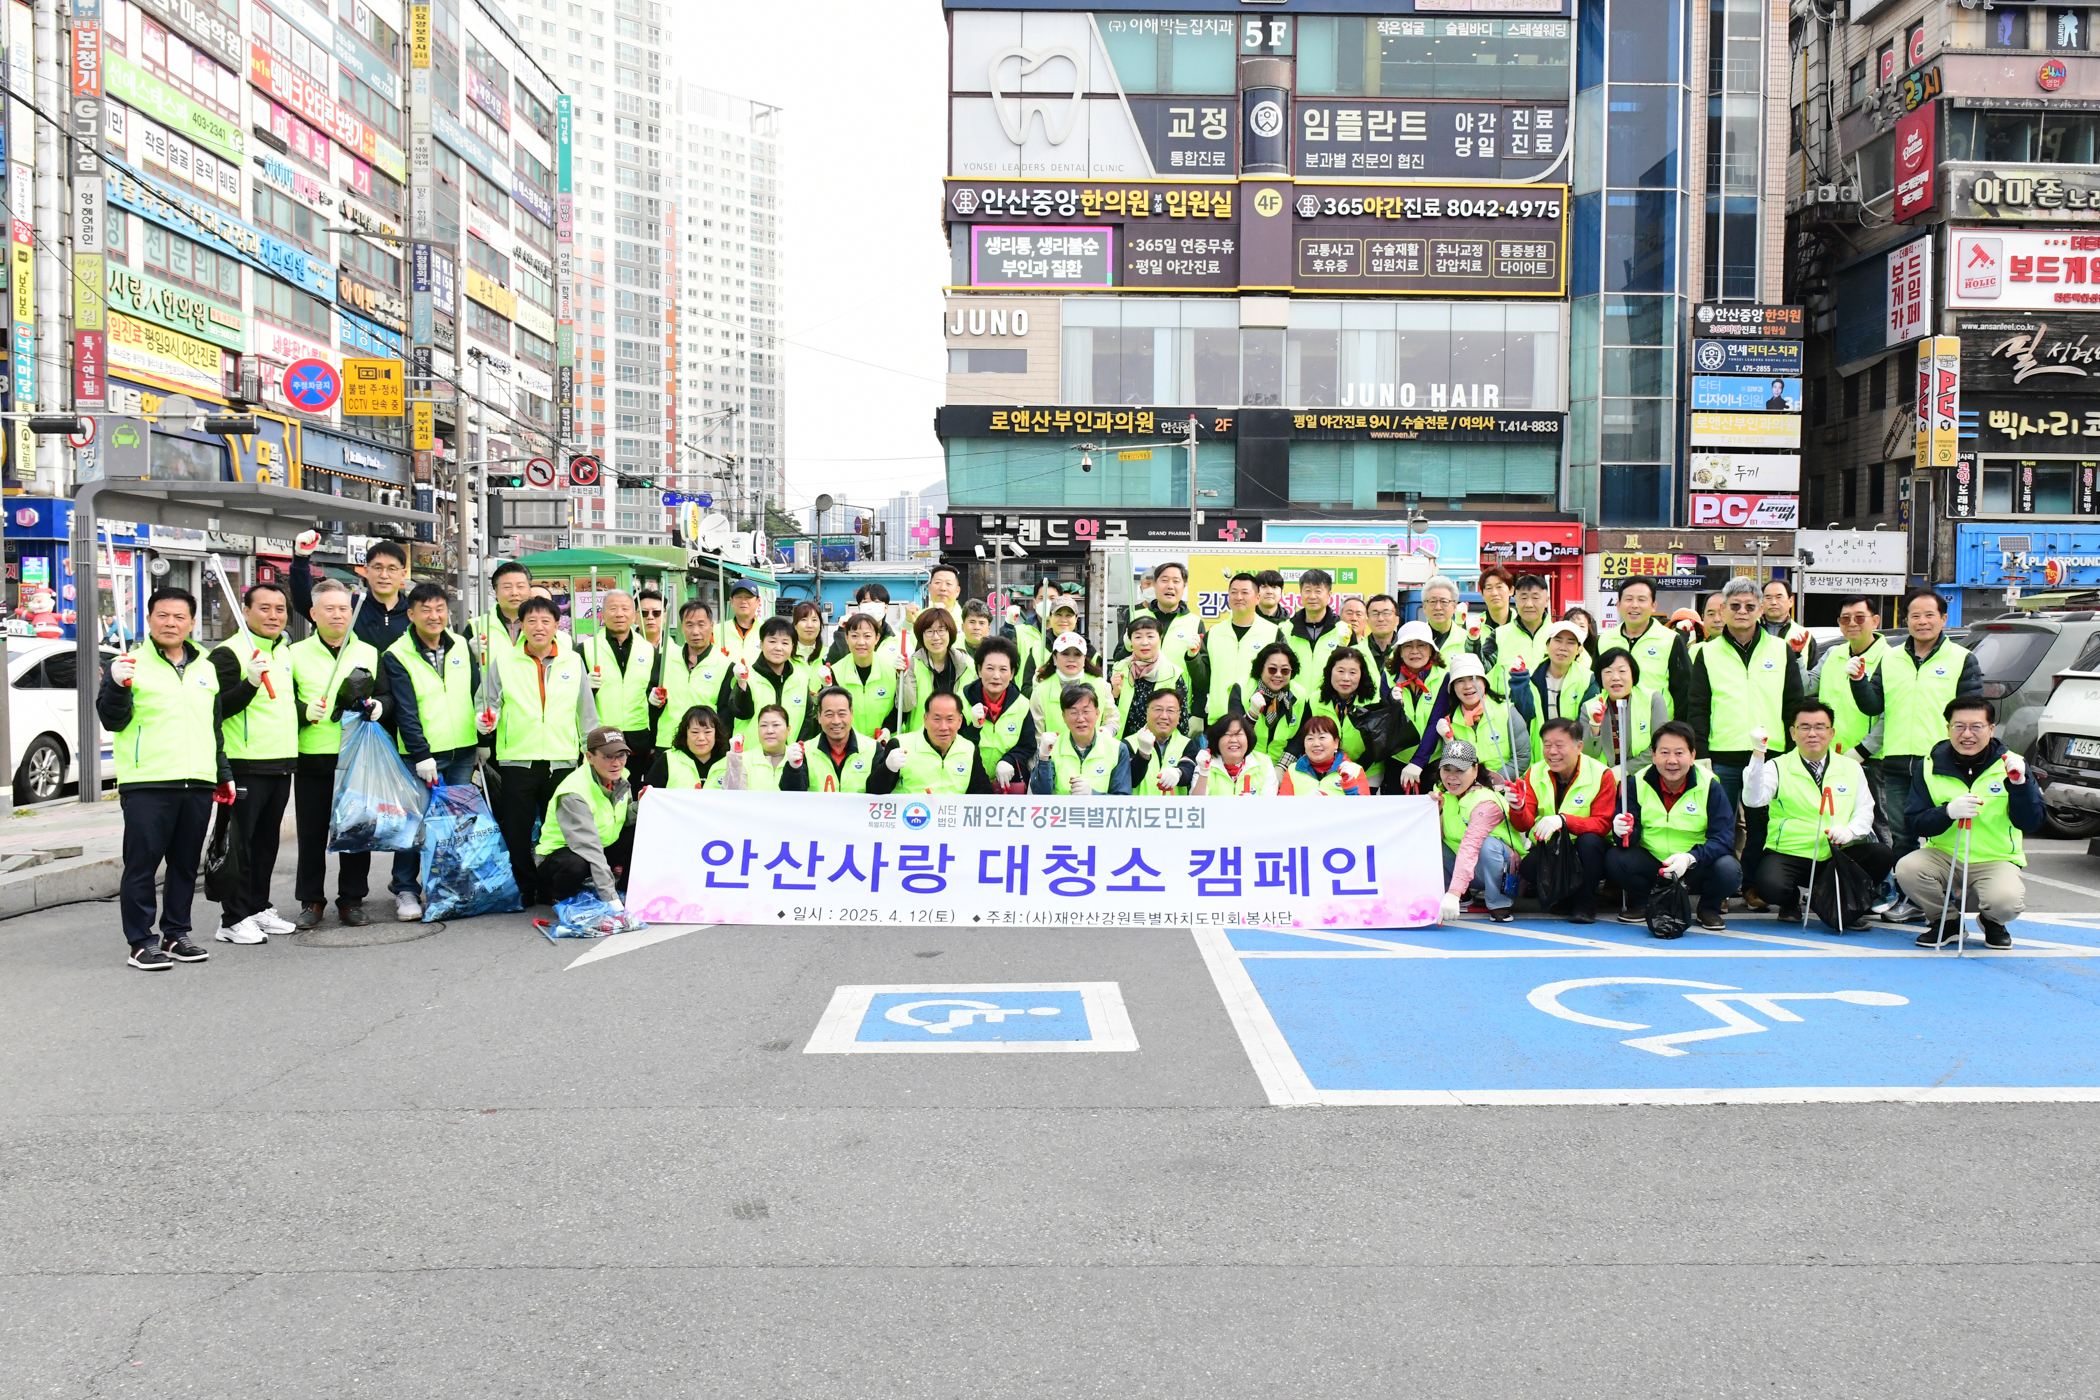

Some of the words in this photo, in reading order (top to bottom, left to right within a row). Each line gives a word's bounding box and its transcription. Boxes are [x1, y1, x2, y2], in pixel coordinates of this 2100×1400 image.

[415, 13, 427, 50] 요양보호사
[1108, 20, 1127, 33] (구)
[1130, 18, 1234, 36] 이해박는집치과
[1245, 21, 1287, 48] 5F
[1377, 21, 1425, 35] 작은얼굴
[1445, 21, 1493, 36] 슬림바디
[1507, 23, 1567, 38] 스페셜웨딩
[76, 29, 97, 90] 보청기
[1904, 66, 1942, 111] 25시
[192, 112, 226, 141] 403-2341
[1168, 107, 1228, 140] 교정
[1303, 108, 1427, 142] 임플란트
[1455, 112, 1497, 134] 야간
[1512, 110, 1554, 130] 진료
[1454, 136, 1495, 158] 당일
[1512, 134, 1554, 155] 진료
[1170, 151, 1226, 167] 통합진료
[1305, 153, 1347, 169] 분과별
[1351, 153, 1393, 169] 전문의
[1397, 154, 1425, 170] 협진
[963, 162, 998, 172] YONSEI
[1002, 163, 1046, 172] LEADERS
[1051, 164, 1087, 172] DENTAL
[1093, 164, 1125, 173] CLINIC
[1975, 178, 2065, 208] 아마존
[1165, 190, 1232, 218] 입원실
[1257, 195, 1279, 210] 4F
[1323, 197, 1442, 218] 365야간진료
[985, 237, 1036, 257] 생리통,
[1036, 237, 1100, 256] 생리불순
[1135, 238, 1178, 255] 365일
[1180, 239, 1235, 255] 연중무휴
[1307, 243, 1354, 257] 교통사고
[1371, 243, 1420, 257] 수술재활
[1436, 243, 1483, 257] 추나교정
[1500, 244, 1547, 258] 통증봉침
[1001, 259, 1049, 278] 부인과
[1051, 260, 1083, 278] 질환
[1135, 259, 1164, 275] 평일
[1166, 259, 1221, 275] 야간진료
[1312, 259, 1349, 274] 후유증
[1372, 259, 1419, 273] 입원치료
[1436, 259, 1483, 273] 감압치료
[1500, 261, 1547, 275] 다이어트
[1964, 278, 1997, 289] HOLIC
[80, 268, 97, 327] 한의원
[950, 308, 1029, 337] JUNO
[1961, 322, 2035, 331] www.ansanfeel.co.kr
[1901, 329, 1910, 340] 4F
[182, 341, 218, 368] 야간진료
[1728, 345, 1799, 358] 연세리더스치과
[293, 381, 331, 391] 주정차금지
[348, 383, 366, 397] 불법
[1699, 380, 1722, 393] 닥터
[1341, 382, 1417, 408] JUNO
[1431, 383, 1500, 409] HAIR
[1698, 394, 1764, 408] 디자이너의원
[348, 398, 368, 411] CCTV
[372, 398, 388, 411] 단속
[392, 399, 399, 411] 중
[989, 410, 1155, 434] 로앤산부인과의원
[1214, 418, 1233, 432] 2F
[1293, 414, 1318, 429] 평일
[1320, 414, 1368, 429] 야간진료
[1370, 414, 1391, 430] 9시
[1401, 415, 1449, 430] 수술전문
[1459, 416, 1495, 430] 여의사
[1498, 420, 1559, 433] T.414-8833
[1695, 416, 1797, 432] 로앤산부인과의원
[1370, 430, 1419, 439] www.roen.kr
[571, 487, 600, 496] 우회전금지
[1957, 485, 1969, 516] 노래방
[1694, 496, 1749, 525] PC
[982, 519, 1128, 547] 랜드약국
[1516, 541, 1553, 562] PC
[1553, 546, 1579, 556] CAFE
[1341, 571, 1354, 581] 검색
[1657, 578, 1702, 586] 사전무인정산기
[1809, 576, 1842, 587] 봉산빌딩
[1846, 577, 1889, 588] 지하주차장
[868, 802, 897, 820] 강원
[937, 804, 957, 816] 사단
[868, 821, 897, 829] 특별자치도
[937, 817, 957, 828] 법인
[701, 839, 956, 896] 안산사랑
[978, 844, 1166, 898] 대청소
[1187, 844, 1378, 898] 캠페인
[793, 907, 822, 922] 일시
[840, 909, 883, 923] 2025.
[888, 909, 903, 923] 4.
[908, 909, 955, 925] 12(토)
